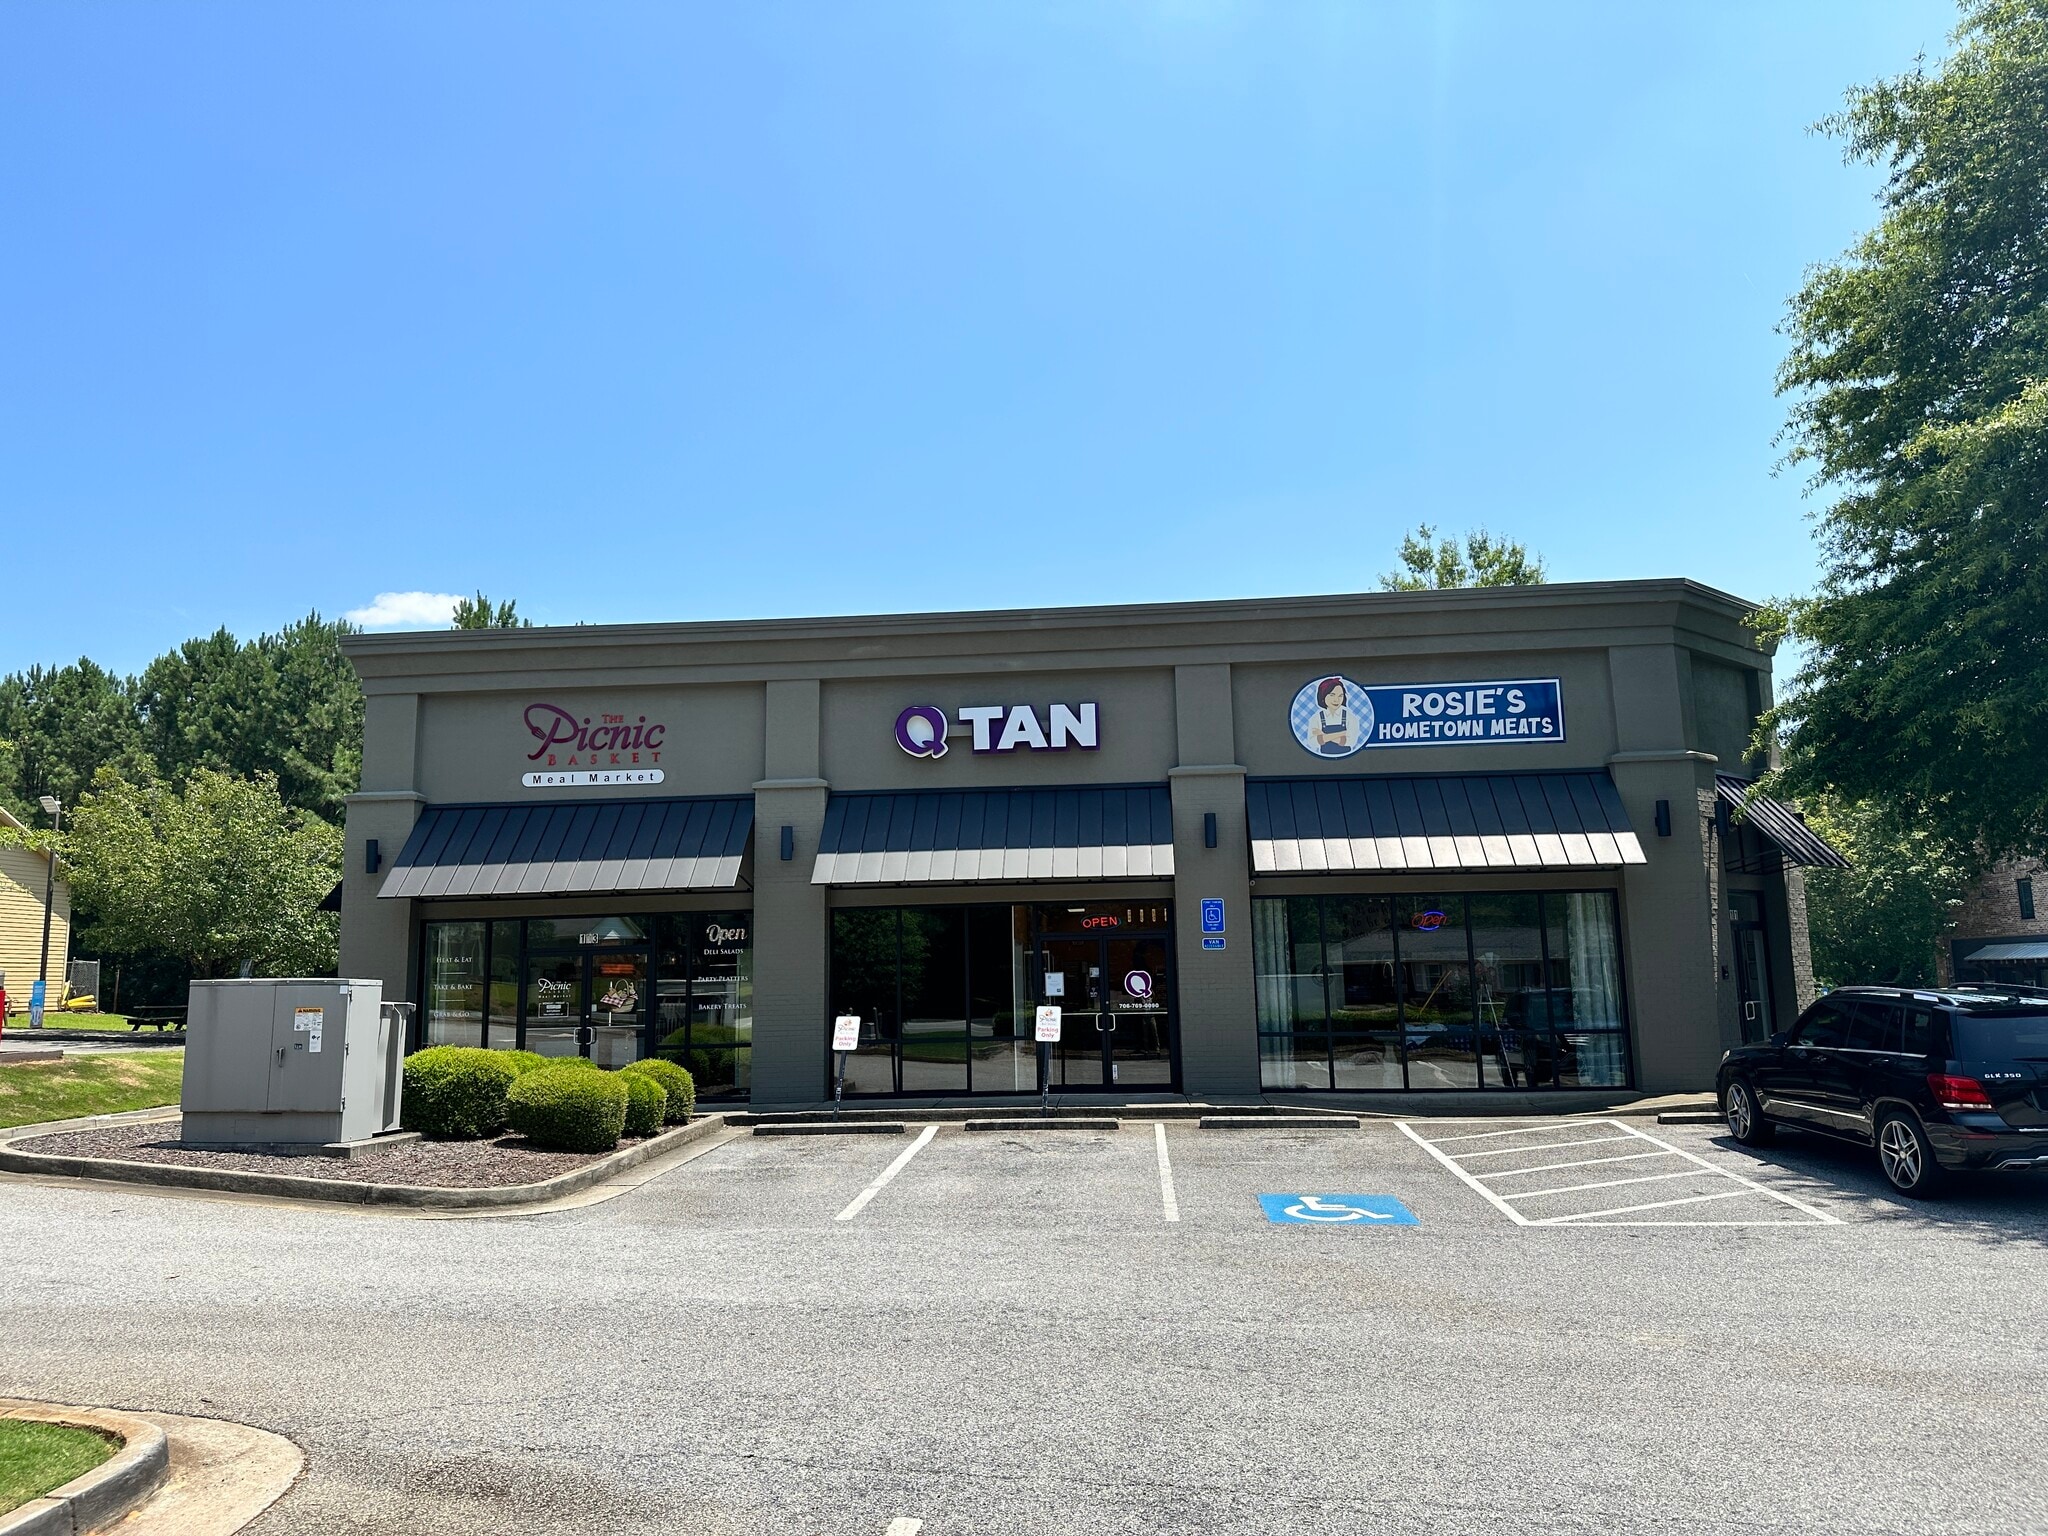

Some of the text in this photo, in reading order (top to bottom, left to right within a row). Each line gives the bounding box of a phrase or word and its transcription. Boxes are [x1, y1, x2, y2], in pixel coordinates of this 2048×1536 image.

[1402, 688, 1526, 718] ROSIE'S
[602, 714, 624, 723] THE
[523, 703, 666, 760] Picnic
[1378, 717, 1554, 740] HOMETOWN MEATS
[547, 752, 661, 766] BASKET
[532, 773, 654, 784] Meal Market
[1082, 916, 1118, 928] OPEN
[1412, 913, 1447, 928] Open
[706, 924, 748, 945] Open
[538, 978, 572, 993] Picnic
